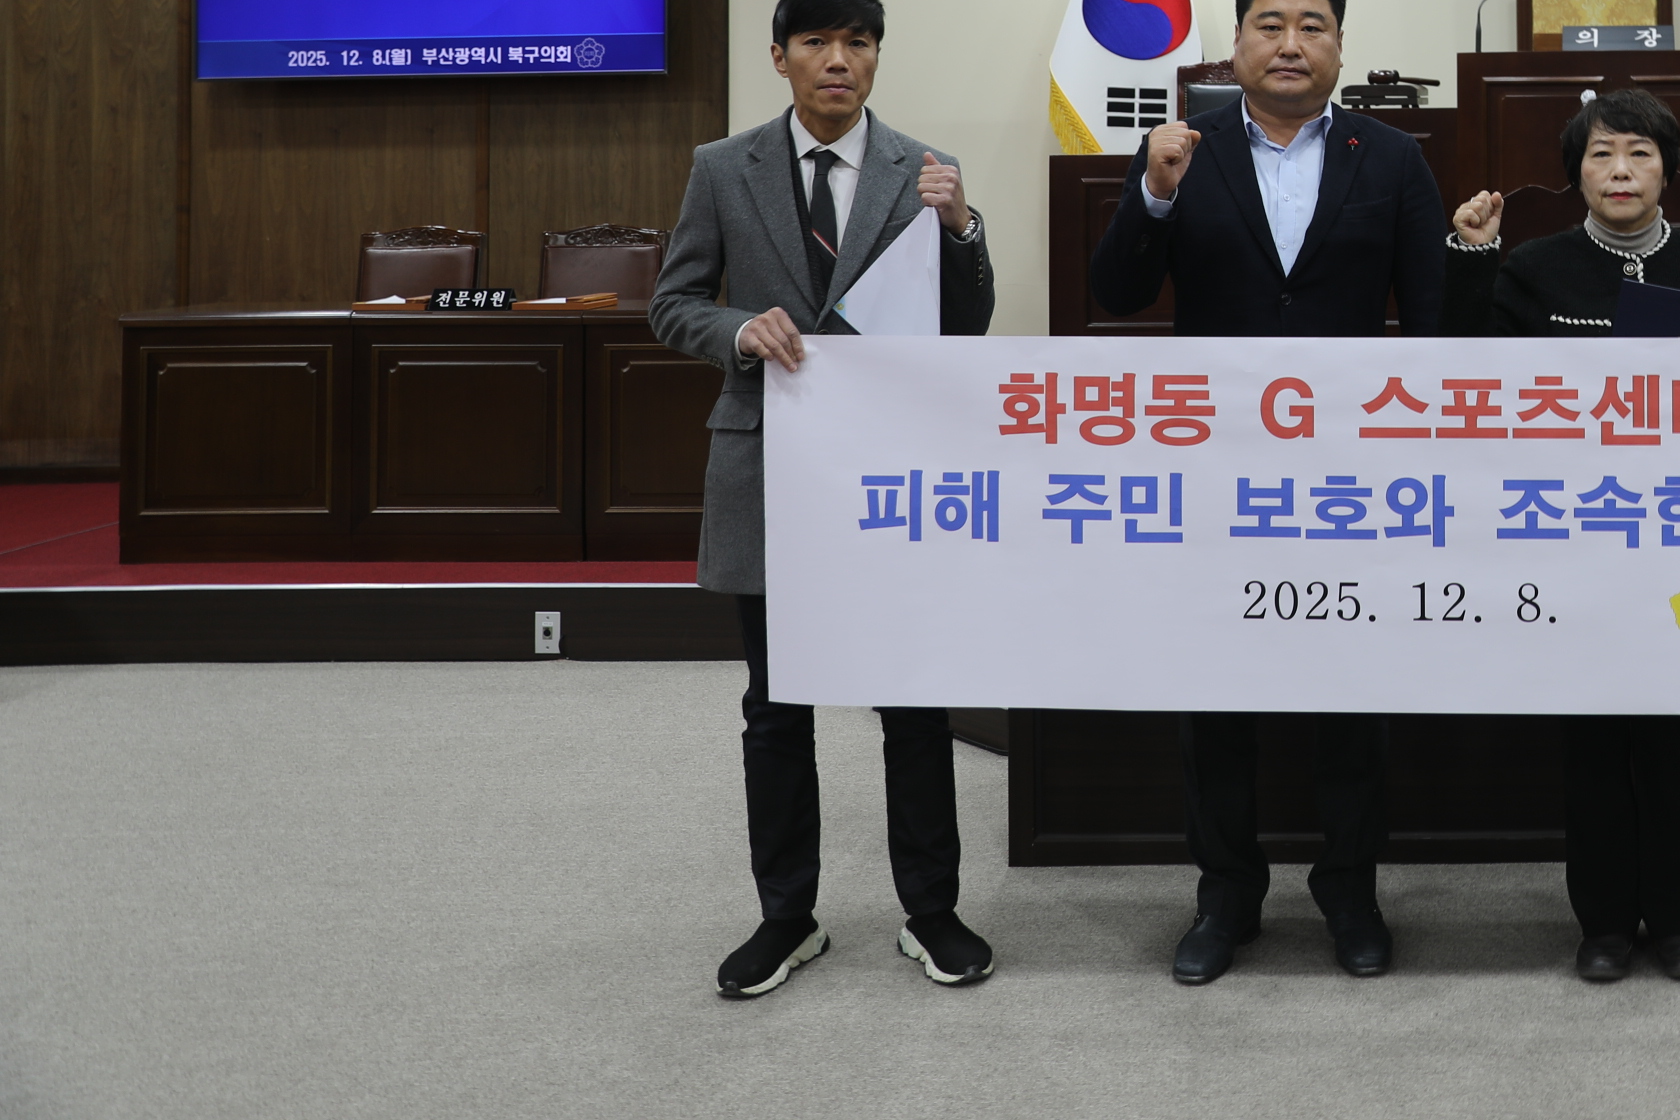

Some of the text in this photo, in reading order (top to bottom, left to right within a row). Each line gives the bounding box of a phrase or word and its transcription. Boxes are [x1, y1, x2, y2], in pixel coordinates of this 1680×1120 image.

[288, 50, 330, 67] 2025.
[341, 49, 363, 66] 12.
[422, 46, 502, 66] 부산광역시
[507, 45, 572, 64] 북구의회
[435, 290, 506, 308] 전문위원
[998, 373, 1216, 447] 화명동
[1260, 377, 1315, 440] G
[858, 469, 1000, 543] 피해
[1042, 472, 1184, 545] 주민
[1229, 474, 1455, 548] 보호와
[1243, 580, 1377, 623] 2025.
[1412, 581, 1482, 623] 12.
[1516, 582, 1557, 624] 8.
